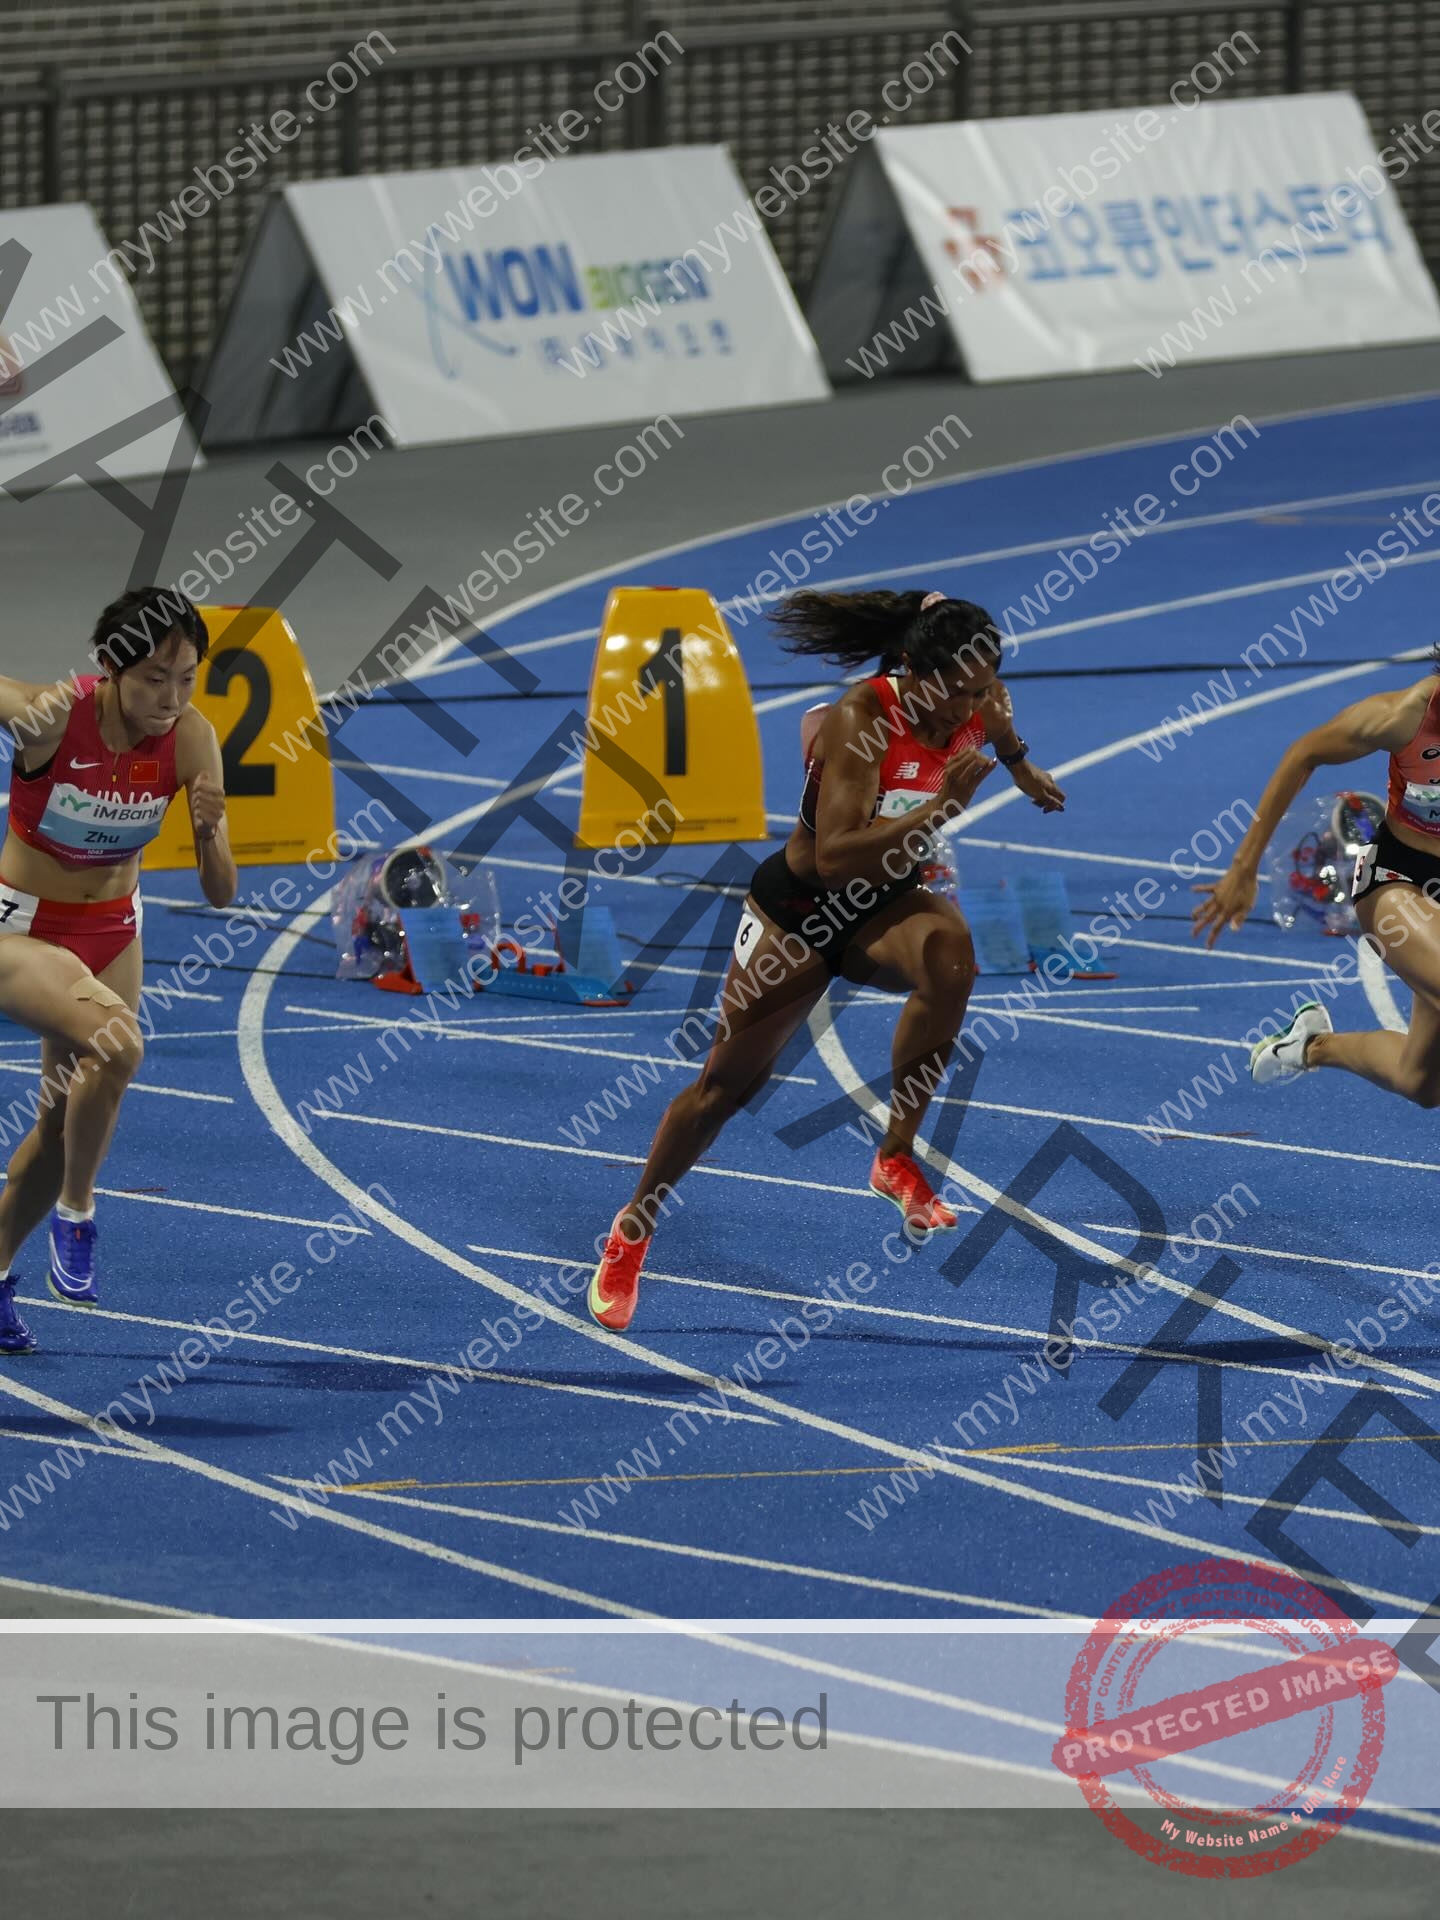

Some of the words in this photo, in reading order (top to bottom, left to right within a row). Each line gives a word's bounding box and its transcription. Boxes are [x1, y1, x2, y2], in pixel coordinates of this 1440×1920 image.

[444, 241, 584, 323] WON
[206, 647, 277, 796] 2
[639, 627, 687, 776] 1
[84, 830, 120, 843] Zhu
[0, 898, 20, 923] 7
[740, 921, 753, 947] 6
